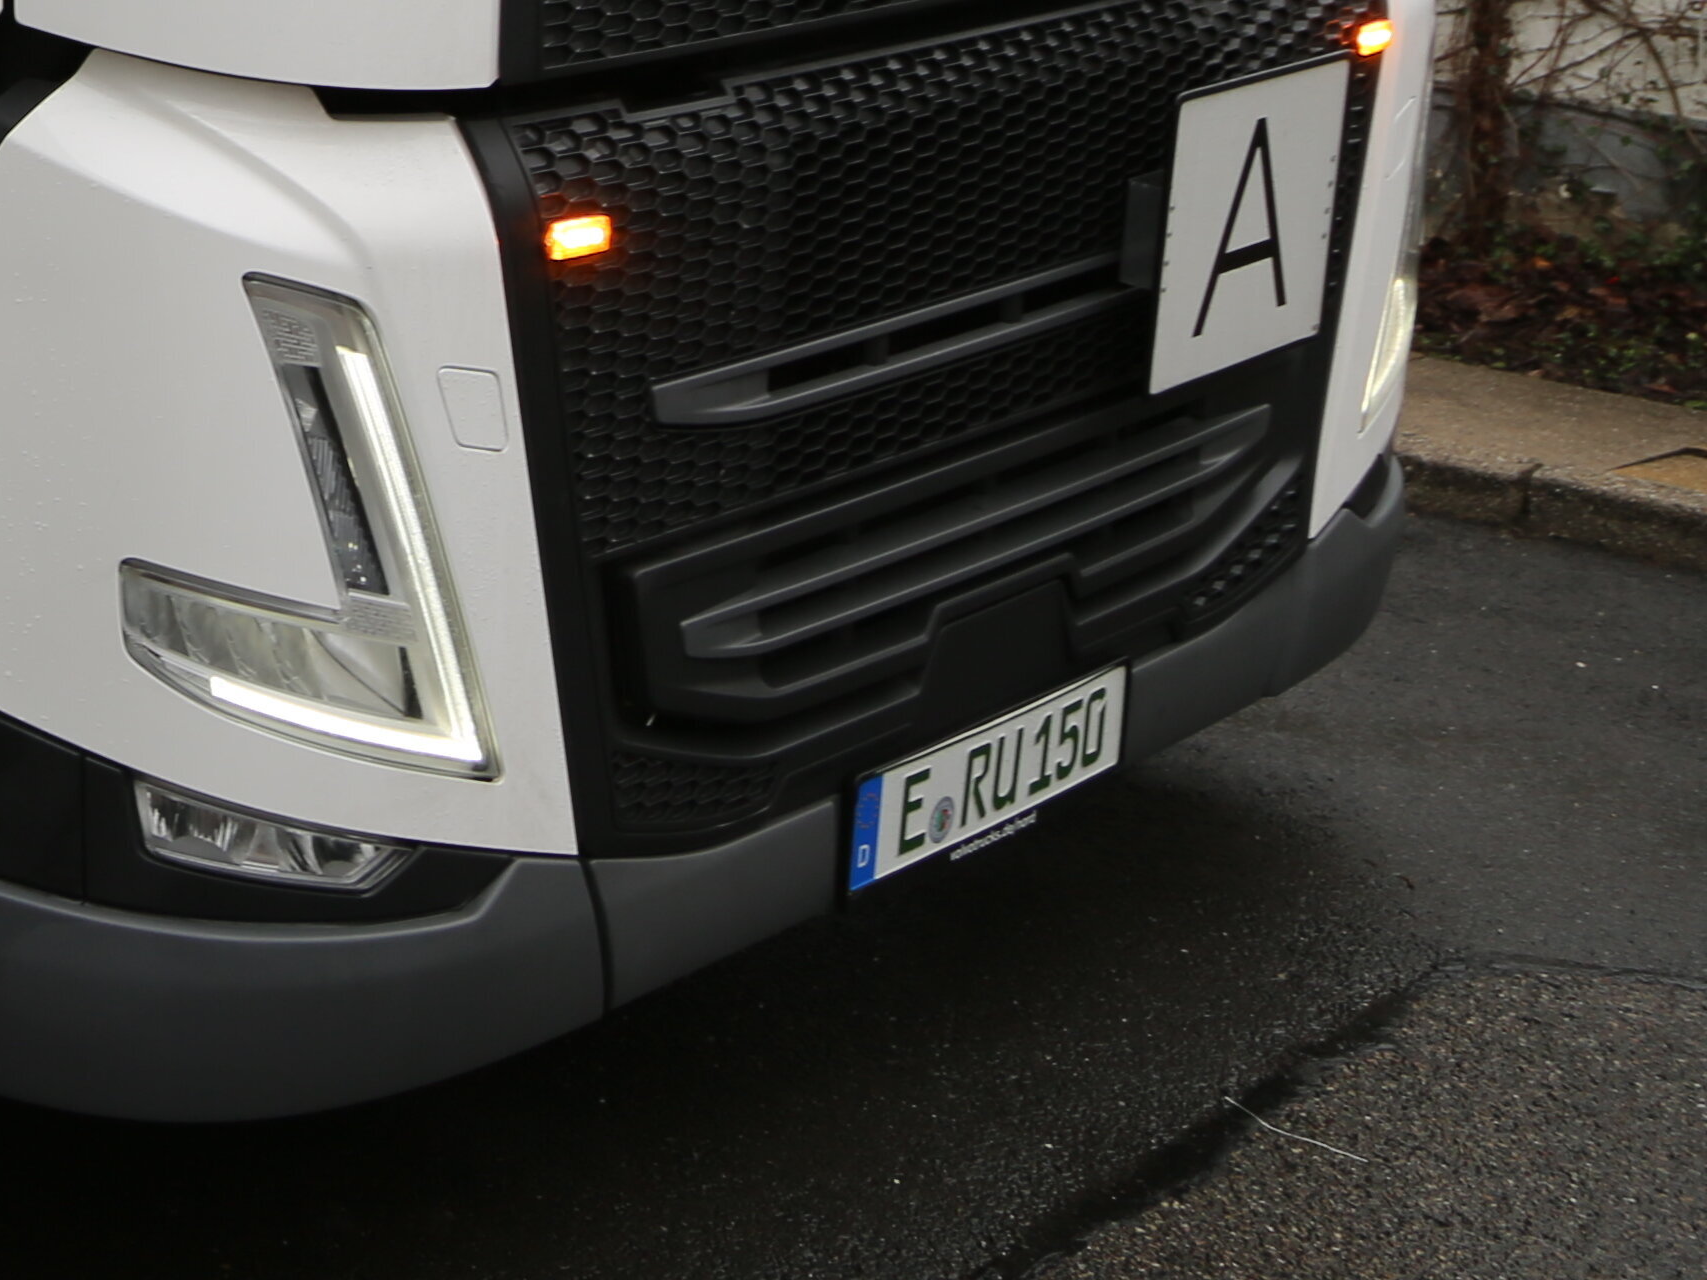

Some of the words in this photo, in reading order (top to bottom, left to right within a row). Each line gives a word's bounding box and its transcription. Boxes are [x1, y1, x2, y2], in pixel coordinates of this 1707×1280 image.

[1192, 116, 1286, 339] A
[856, 843, 870, 869] D
[897, 766, 932, 857] E
